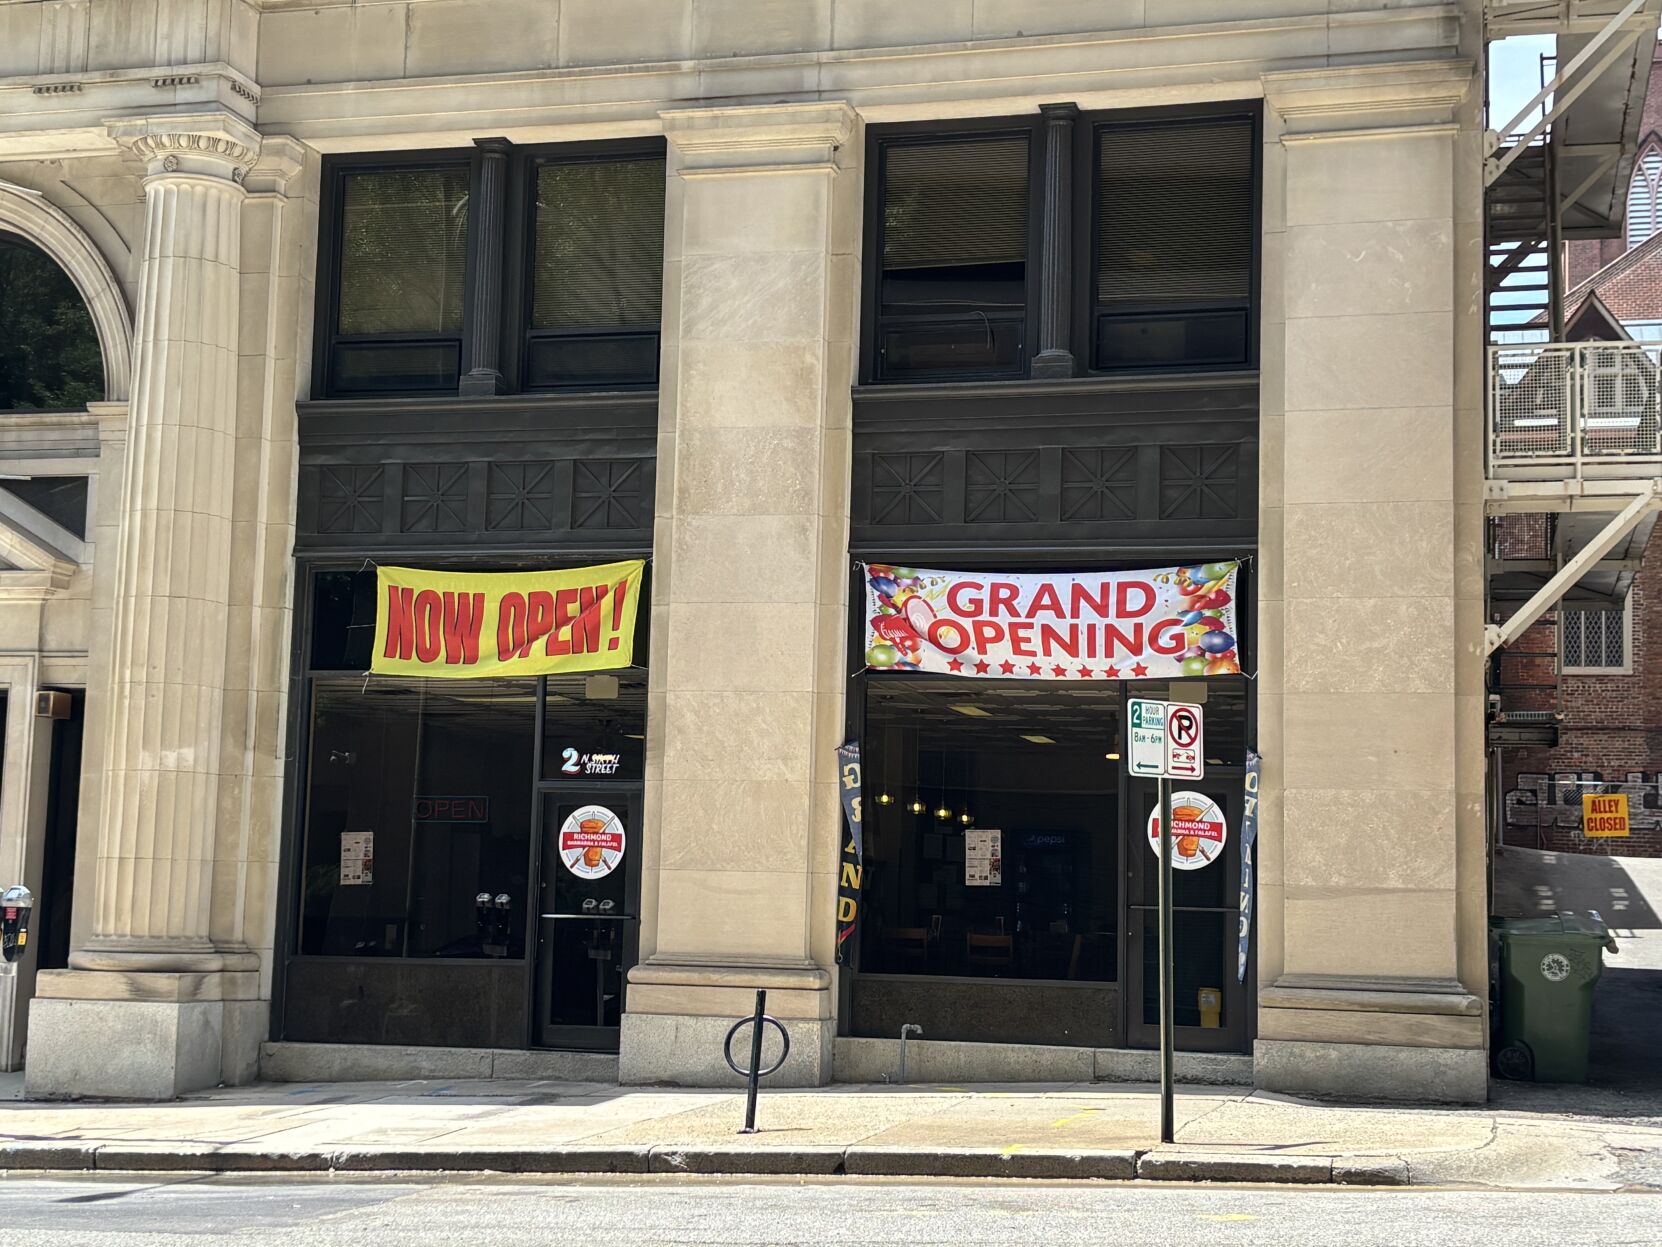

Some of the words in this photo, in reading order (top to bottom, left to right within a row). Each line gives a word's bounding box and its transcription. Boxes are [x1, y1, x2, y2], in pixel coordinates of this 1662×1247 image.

[946, 580, 1157, 620] GRAND
[383, 584, 486, 665] NOW
[496, 578, 628, 662] OPEN!
[927, 617, 1189, 659] OPENING
[1132, 704, 1140, 724] 2
[1144, 705, 1160, 715] HOUR
[1142, 716, 1164, 727] PARKING
[1134, 731, 1146, 743] 8AM
[1150, 733, 1162, 744] 6PM
[561, 747, 581, 775] 2
[585, 763, 620, 774] STREET
[415, 799, 485, 819] OPEN
[1590, 799, 1620, 814] ALLEY
[1171, 821, 1211, 829] ICHMOND
[1586, 816, 1627, 831] CLOSED
[573, 833, 612, 841] RICHMOND
